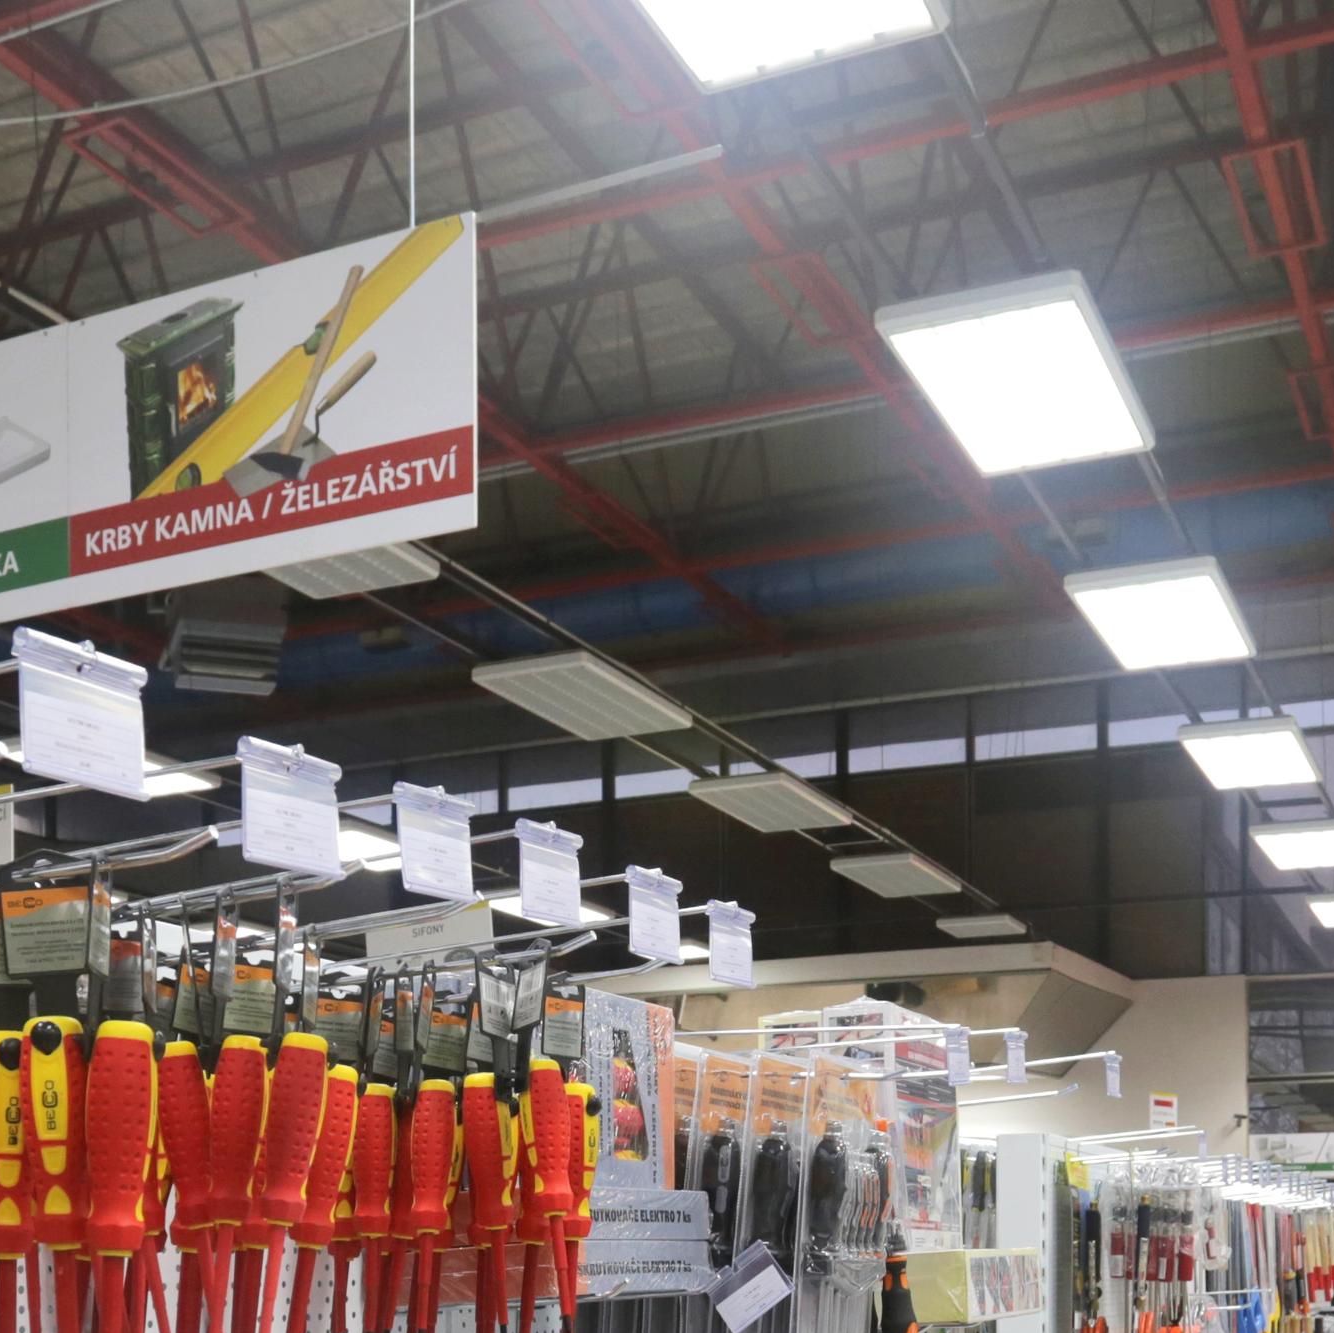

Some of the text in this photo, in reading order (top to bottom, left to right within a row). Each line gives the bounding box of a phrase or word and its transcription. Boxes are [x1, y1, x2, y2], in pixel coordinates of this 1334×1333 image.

[85, 445, 457, 557] KRBY KAMNA / ŽELEZÁŘSTVÍ
[411, 924, 445, 939] SIFONY
[640, 1207, 675, 1224] ELEKTRO
